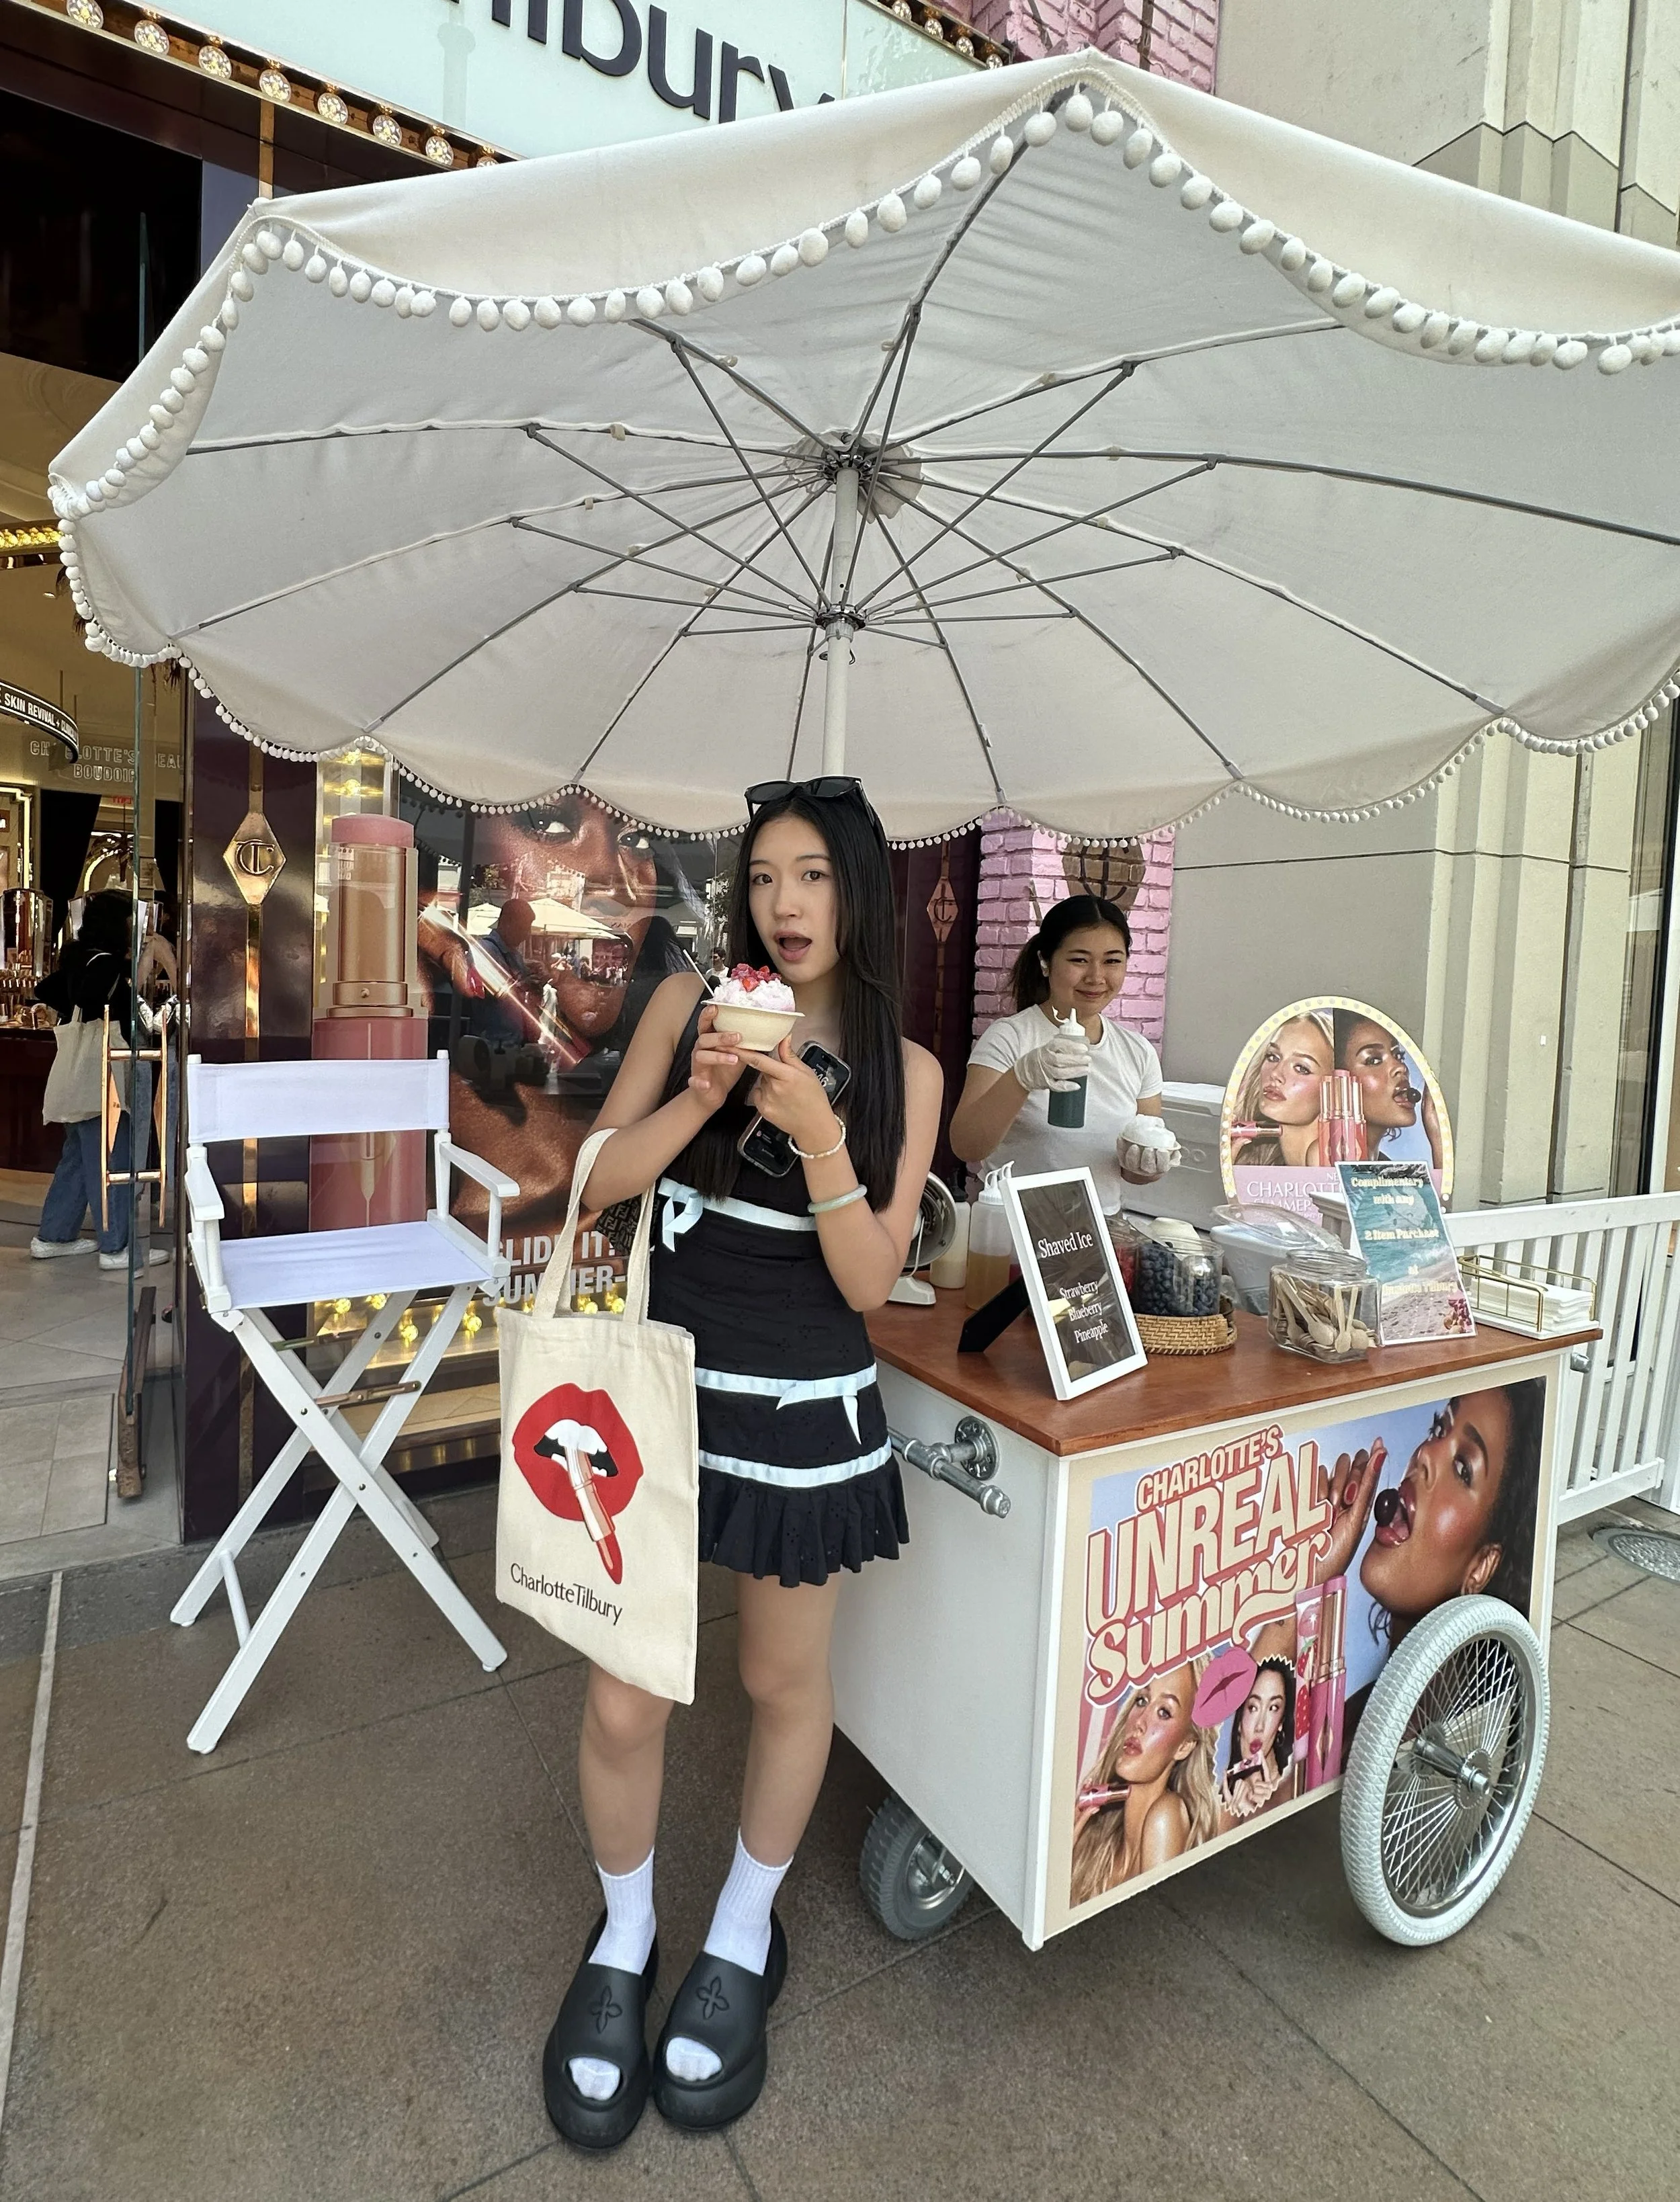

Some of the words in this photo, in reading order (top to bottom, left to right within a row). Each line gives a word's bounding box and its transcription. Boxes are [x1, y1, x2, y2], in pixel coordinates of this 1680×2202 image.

[5, 693, 26, 712] SKIN
[28, 702, 56, 726] REVIVAL
[30, 740, 135, 764] CHOTTE'S
[1351, 1176, 1424, 1189] Complimentary
[1373, 1193, 1394, 1204] with
[1395, 1195, 1415, 1205] any
[1038, 1232, 1078, 1259] Shaved
[1076, 1232, 1093, 1249] Ice
[1364, 1230, 1372, 1240] 2
[1373, 1229, 1396, 1240] Item
[1396, 1228, 1439, 1239] Purchase
[499, 1234, 562, 1267] LID
[1059, 1281, 1099, 1300] Strawberry
[1067, 1302, 1102, 1322] Blueberry
[1074, 1318, 1109, 1343] Pineapple
[1136, 1425, 1284, 1512] CHARLOTTE'S
[1087, 1439, 1333, 1638] UNREAL
